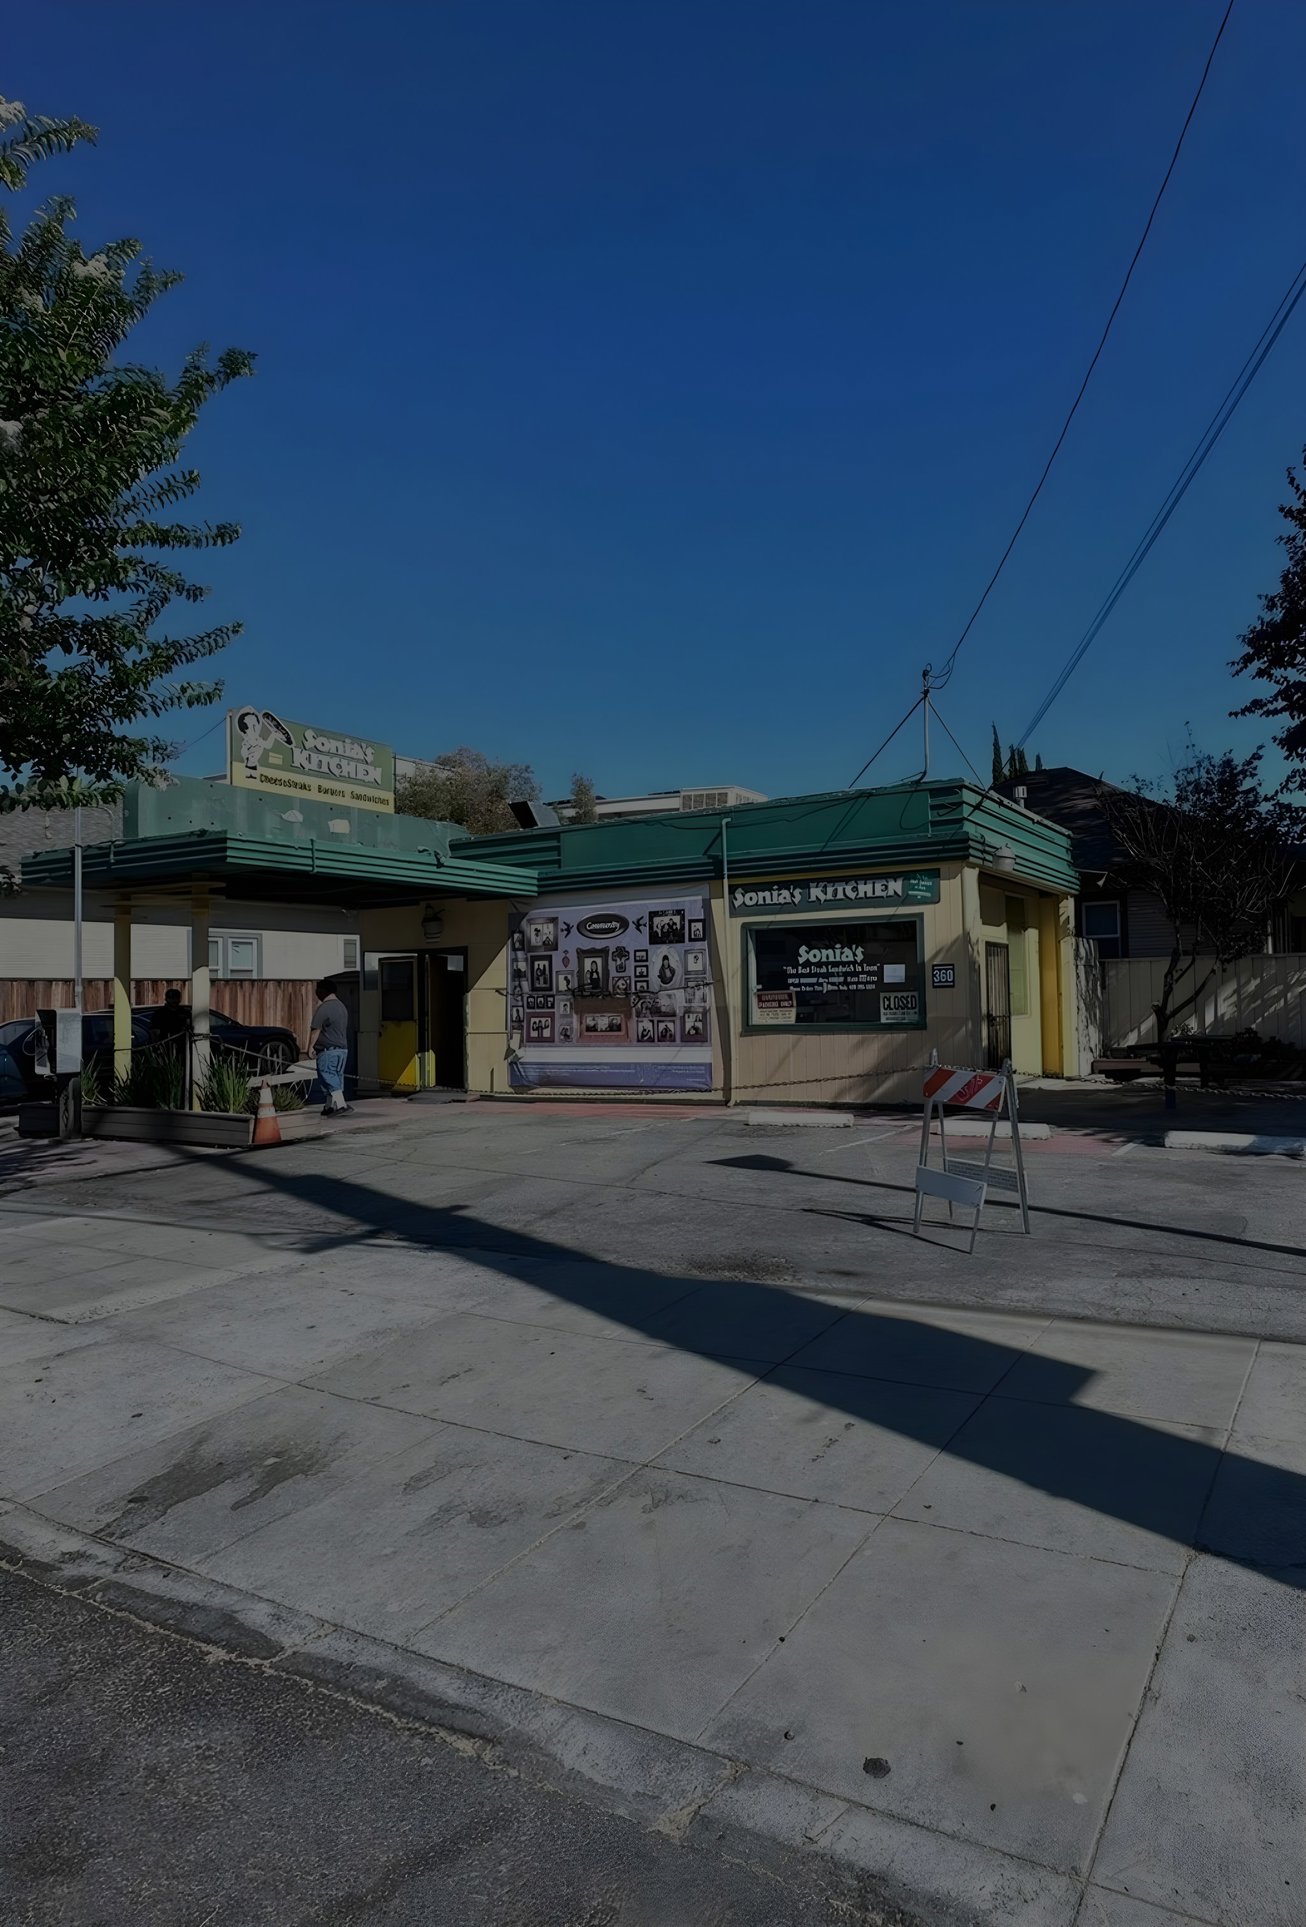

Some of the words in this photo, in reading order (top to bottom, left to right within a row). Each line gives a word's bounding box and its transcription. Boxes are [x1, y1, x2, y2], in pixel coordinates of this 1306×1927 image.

[732, 886, 801, 908] Sonia's
[809, 877, 904, 903] KITCHEN
[798, 944, 864, 963] Sonia's
[933, 969, 954, 983] 360
[883, 995, 917, 1011] CLOSED
